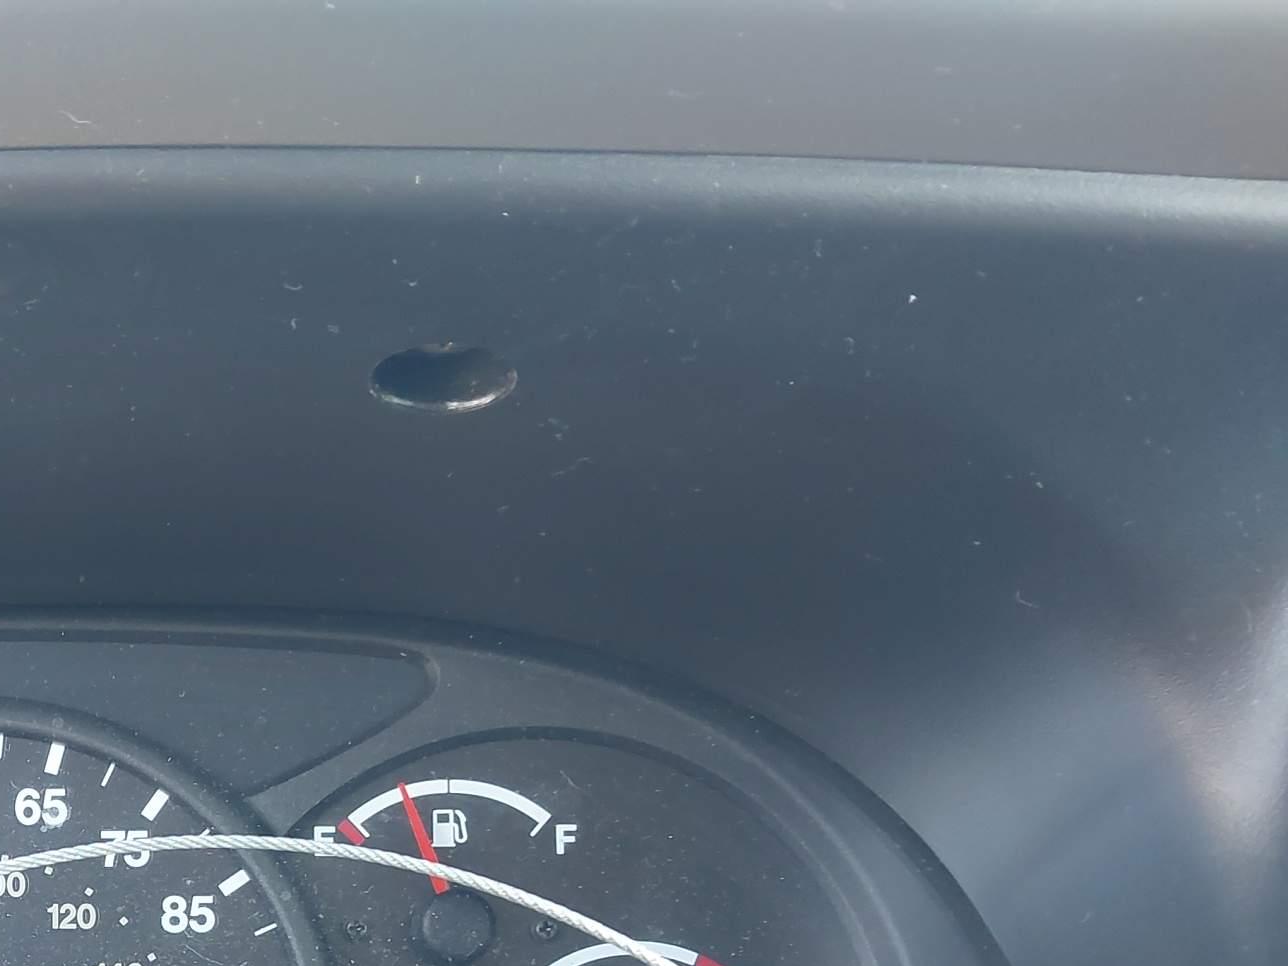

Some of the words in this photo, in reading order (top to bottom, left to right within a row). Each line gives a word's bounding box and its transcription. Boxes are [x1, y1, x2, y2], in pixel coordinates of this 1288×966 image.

[14, 788, 68, 825] 65
[100, 830, 150, 868] 75
[313, 826, 337, 857] E
[553, 823, 577, 855] F
[47, 904, 97, 930] 120
[162, 895, 215, 934] 85
